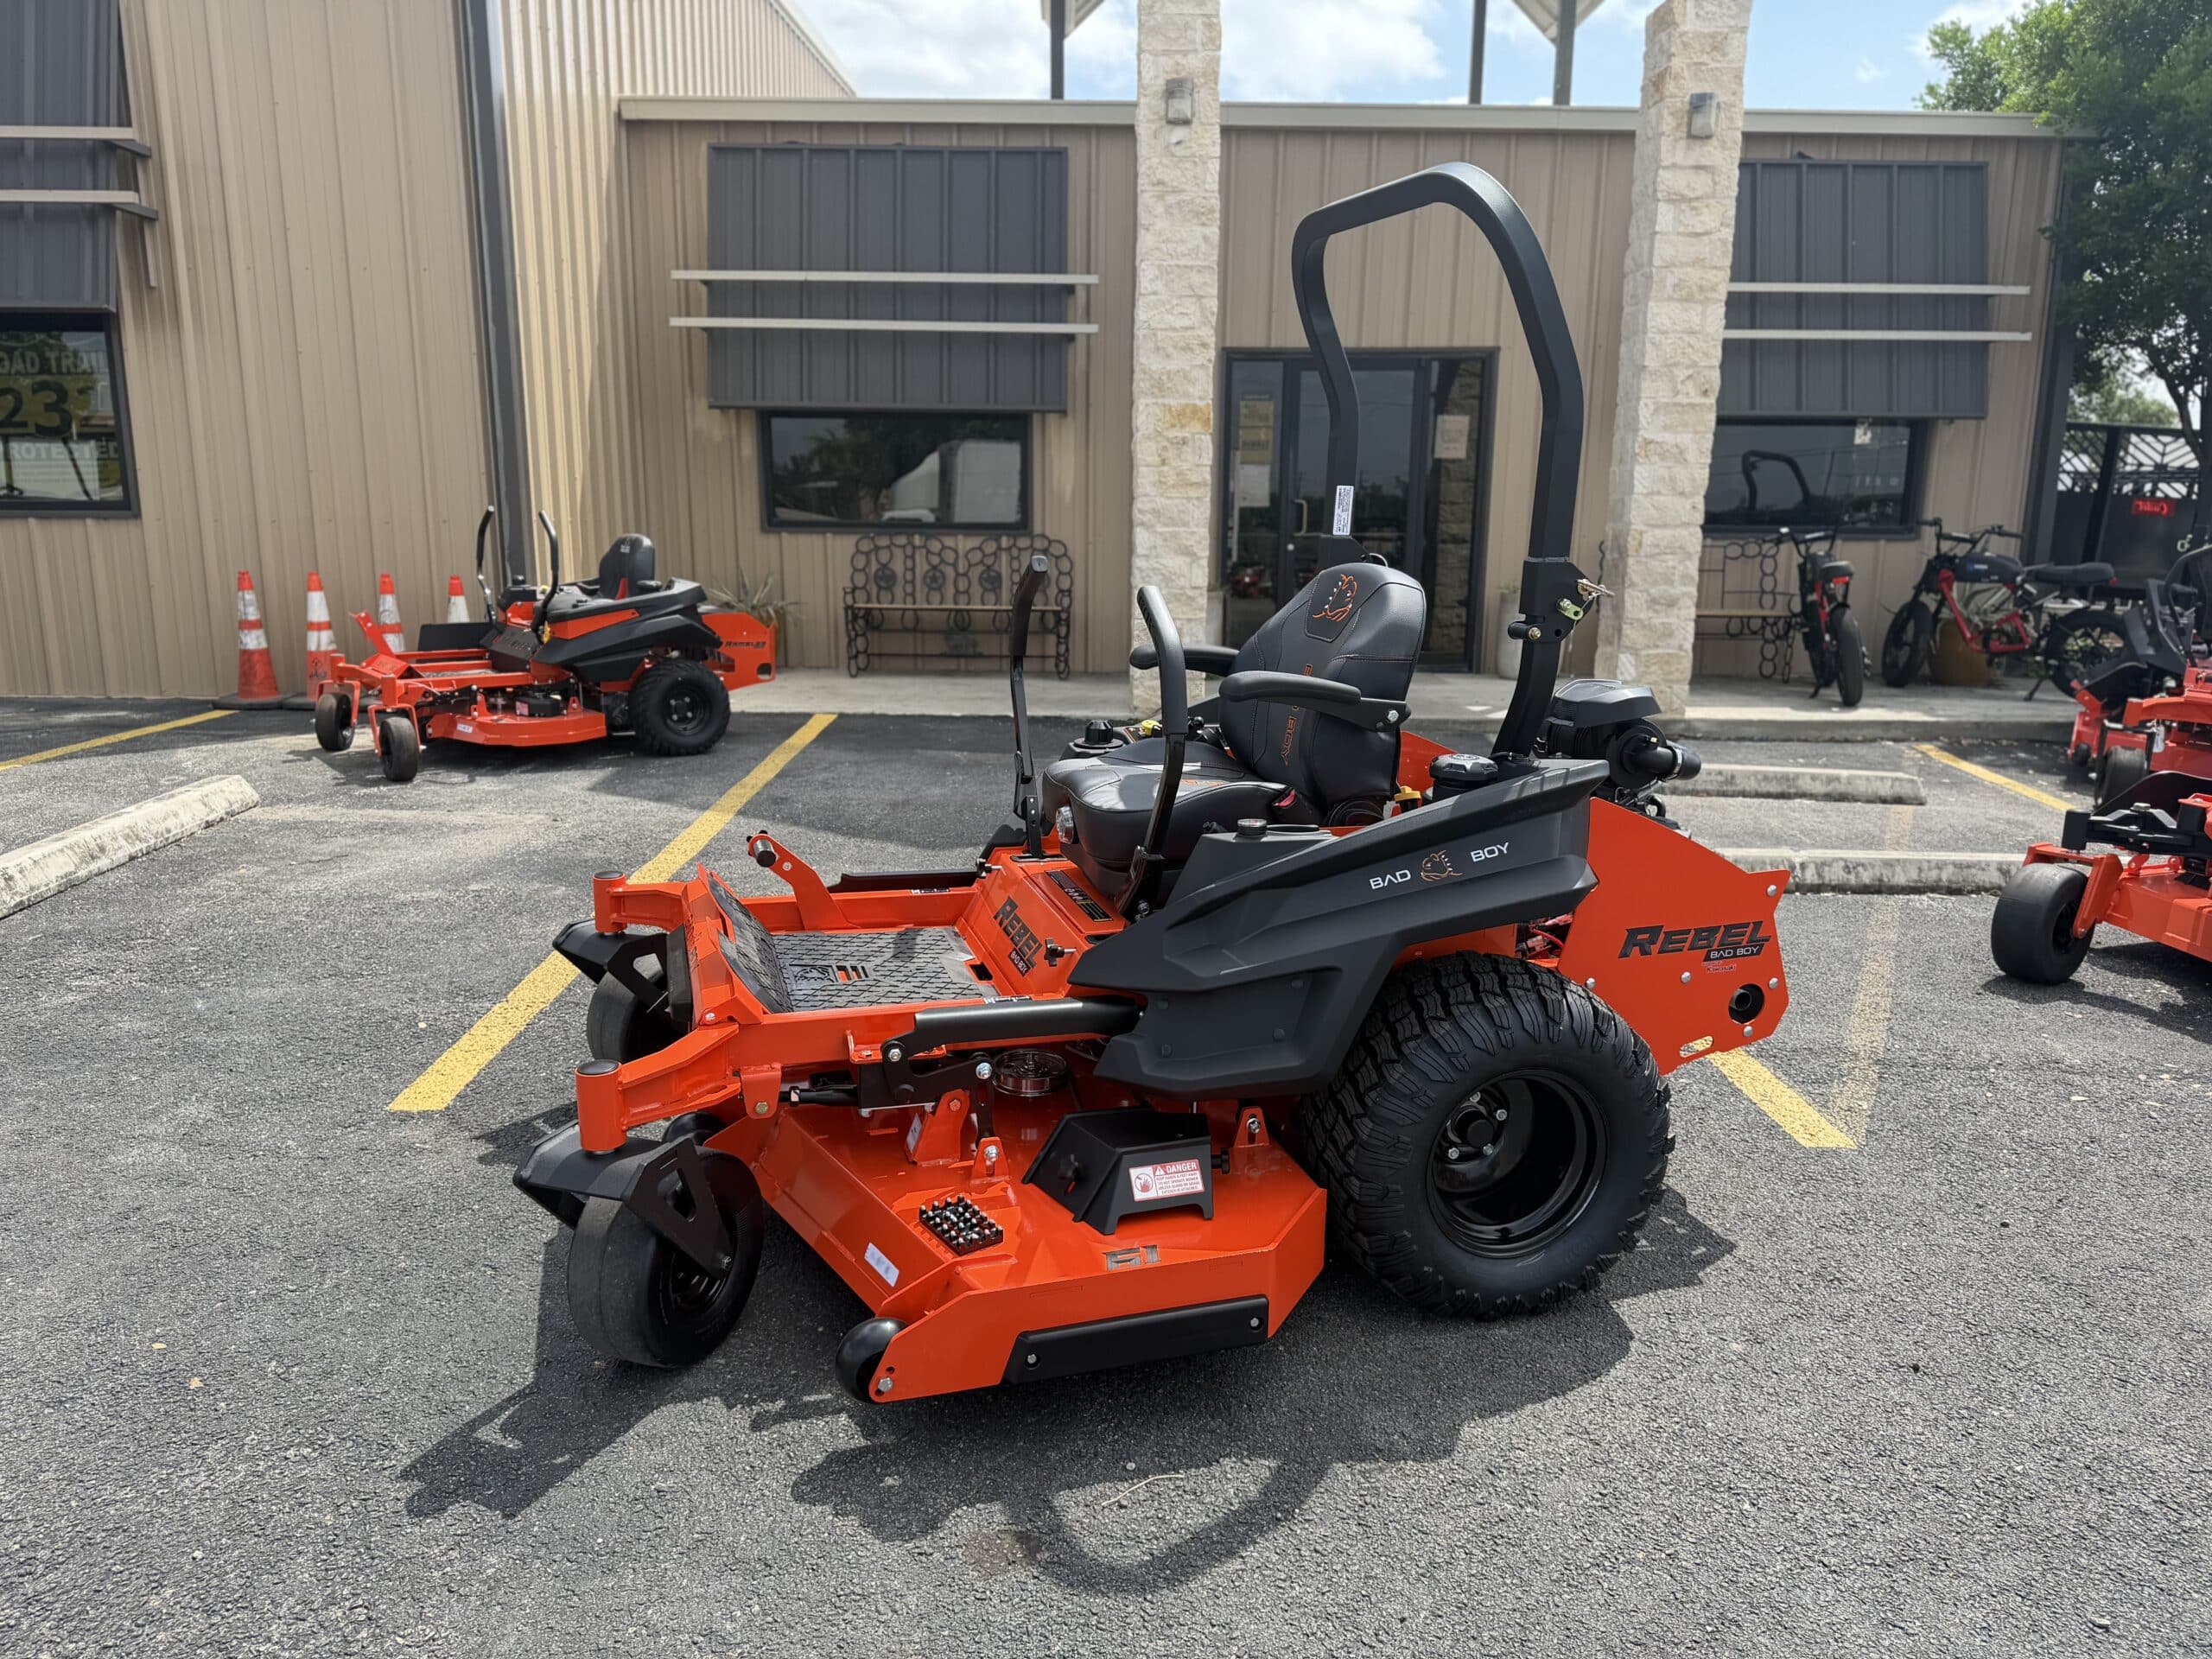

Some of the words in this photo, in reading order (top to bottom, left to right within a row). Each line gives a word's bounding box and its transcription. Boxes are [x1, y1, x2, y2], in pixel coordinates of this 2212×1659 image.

[1370, 869, 1411, 889] BAD
[1471, 842, 1510, 861] BOY
[994, 896, 1042, 969] REBEL
[1618, 921, 1771, 958] REBEL
[1710, 950, 1733, 958] BAD
[1736, 945, 1759, 956] BOY
[1166, 1162, 1197, 1173] DANGER
